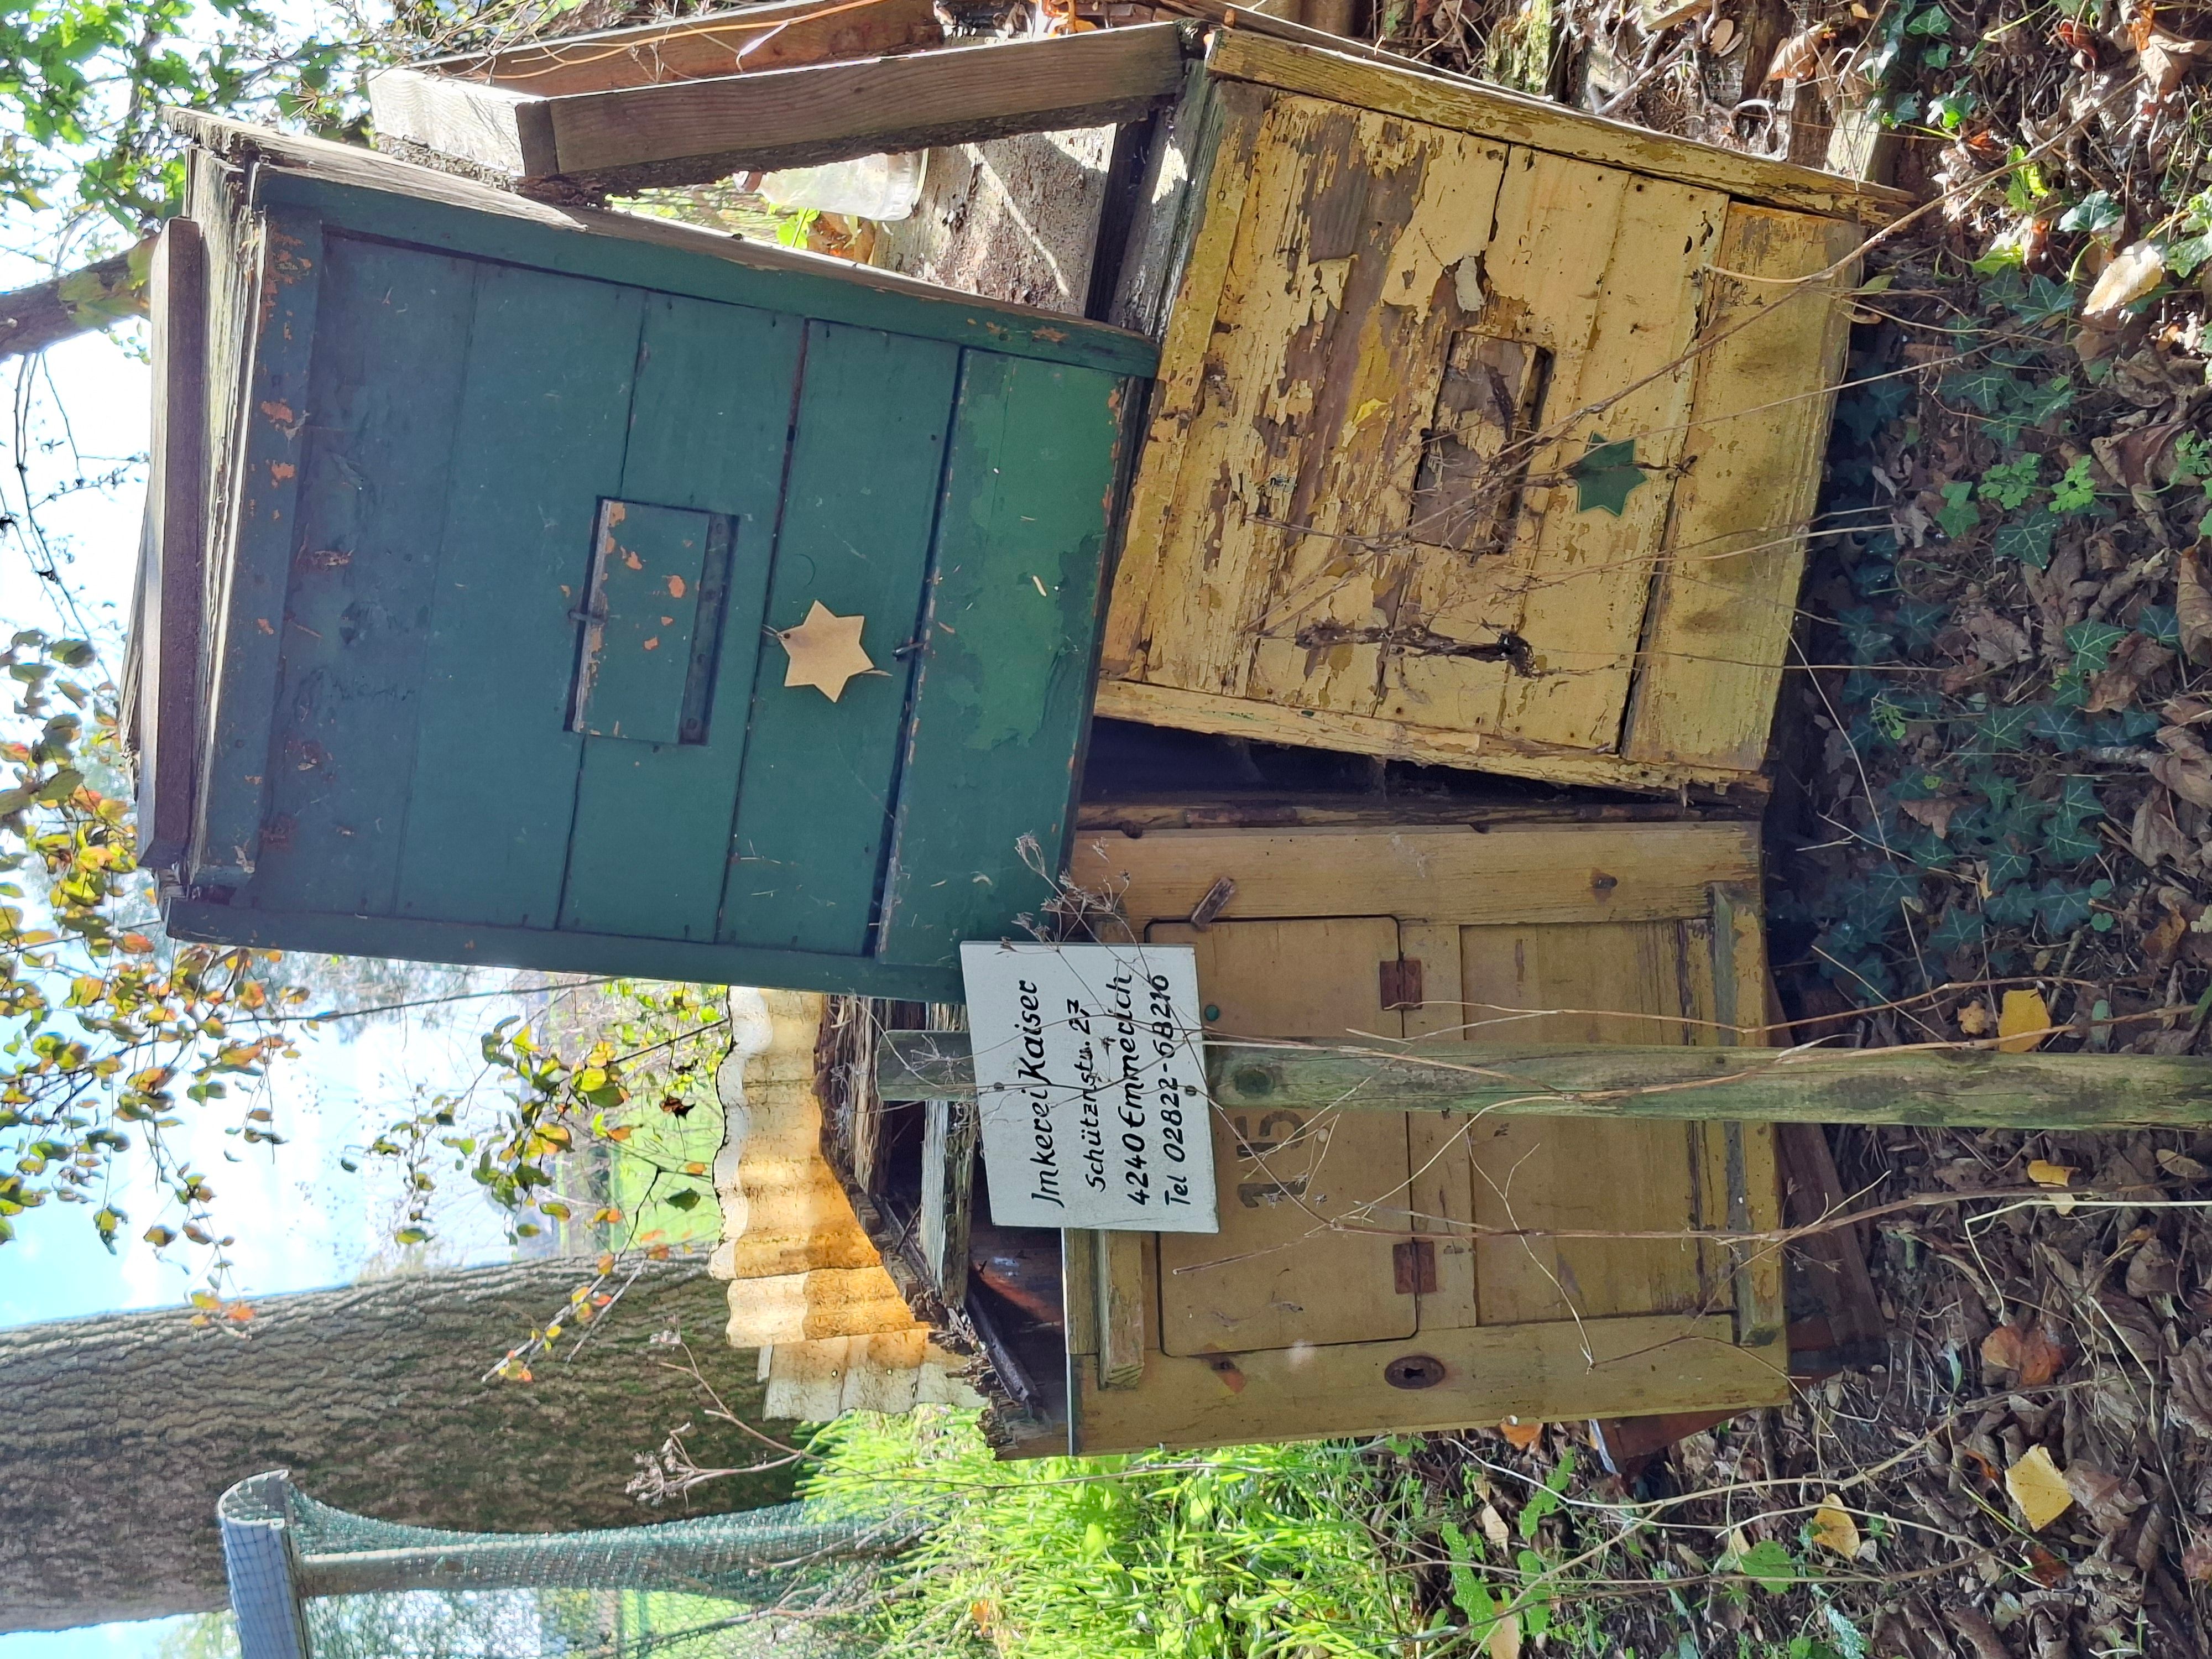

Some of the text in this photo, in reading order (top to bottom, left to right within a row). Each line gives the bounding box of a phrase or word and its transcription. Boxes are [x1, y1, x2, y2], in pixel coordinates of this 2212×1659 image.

[1014, 980, 1050, 1083] Kaiser
[1067, 999, 1091, 1034] 27
[1107, 974, 1149, 1206] 4240 Emmerich
[1165, 1175, 1191, 1206] Tel
